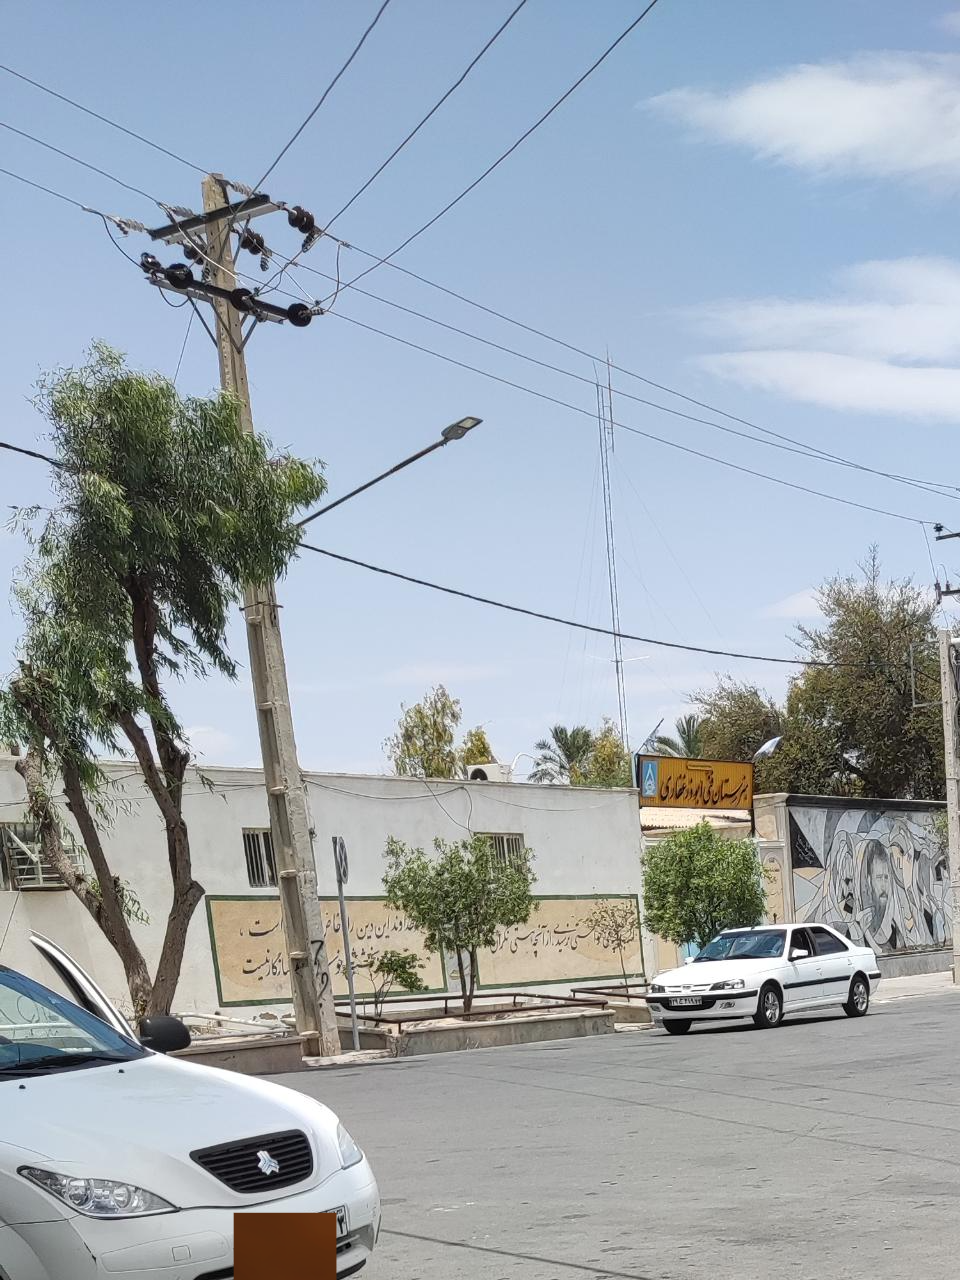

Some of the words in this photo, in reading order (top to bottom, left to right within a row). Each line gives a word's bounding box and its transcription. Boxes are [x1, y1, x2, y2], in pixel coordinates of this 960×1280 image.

[660, 773, 687, 801] غفاری
[685, 777, 704, 805] ابوذر
[702, 770, 714, 805] فنی
[712, 775, 749, 807] هنرستان
[347, 914, 356, 934] را
[355, 922, 374, 940] دین
[374, 913, 390, 939] این
[242, 948, 270, 981] نیست
